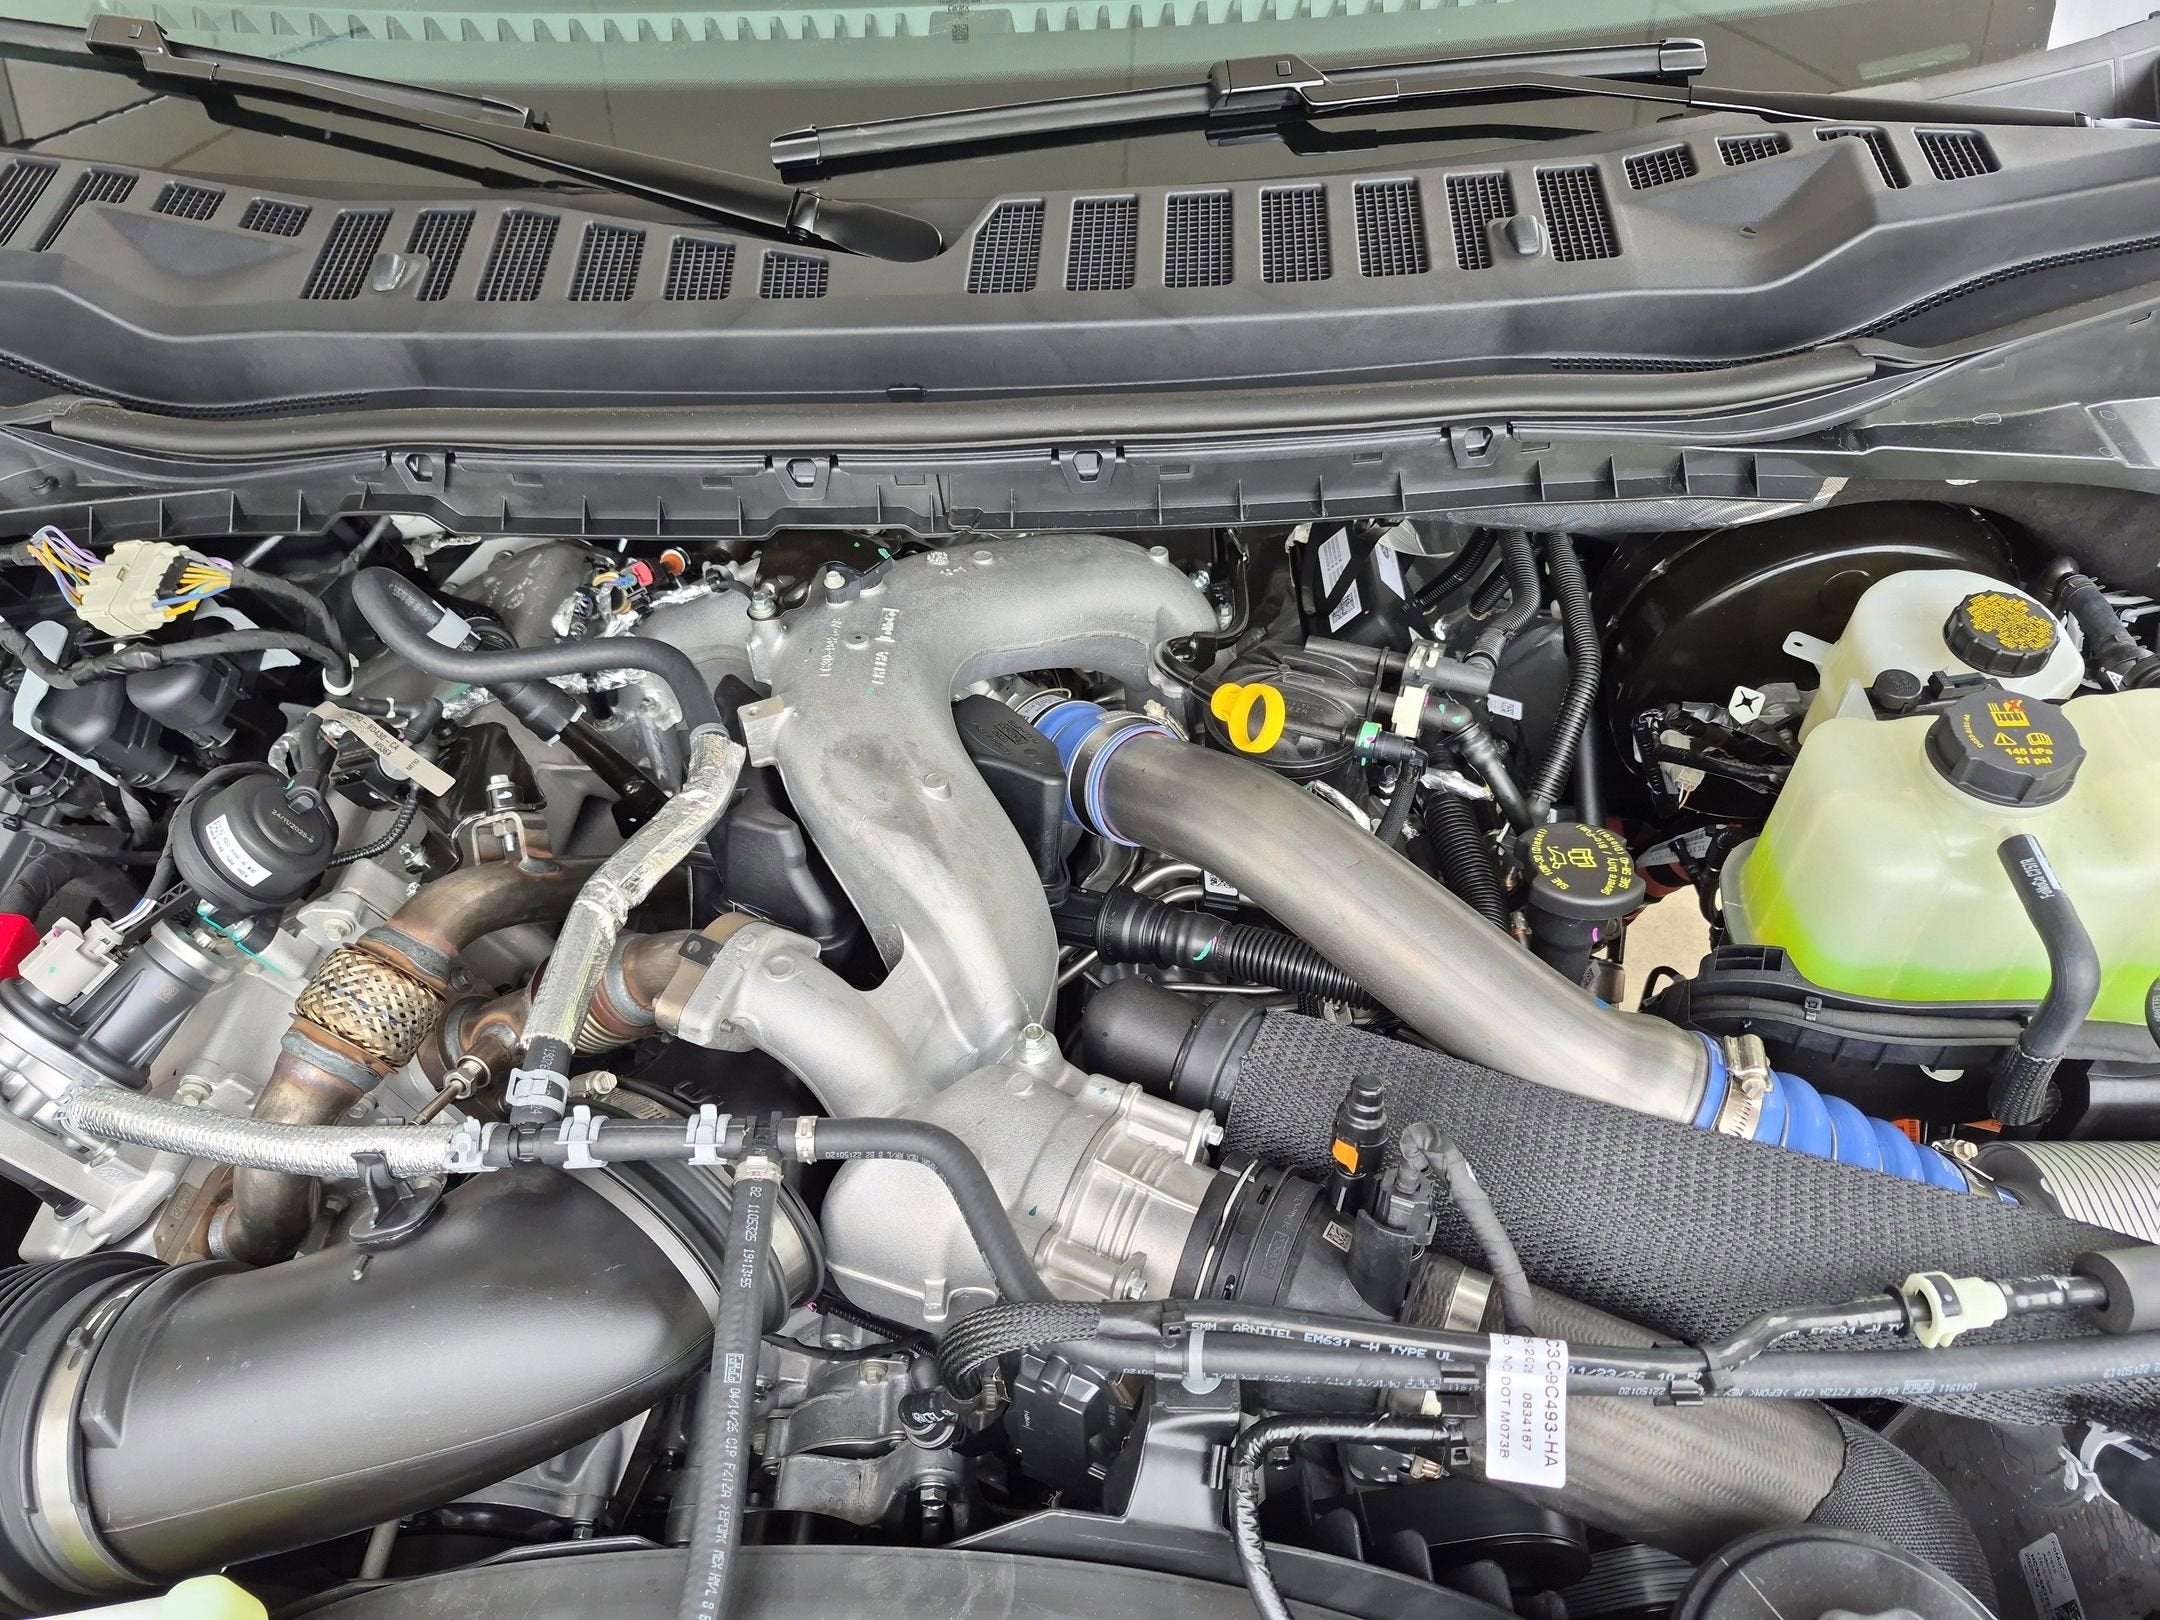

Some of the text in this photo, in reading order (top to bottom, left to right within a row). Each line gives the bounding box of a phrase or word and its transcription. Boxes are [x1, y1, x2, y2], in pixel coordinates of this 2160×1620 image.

[2005, 747, 2054, 756] 145 kPa
[2015, 756, 2053, 766] 21 psi
[2031, 876, 2056, 900] FoMoCo
[825, 1151, 862, 1159] 22:50:20
[744, 1203, 761, 1243] 1105325
[740, 1248, 756, 1289] 19:13:55
[1232, 1322, 1296, 1340] ARNITEL
[1303, 1332, 1351, 1349] EM631
[1389, 1344, 1428, 1359] TYPE
[1436, 1350, 1456, 1362] UL
[2103, 1363, 2151, 1379] 22:50:19
[1500, 1376, 1512, 1407] DOT
[1618, 1386, 1666, 1396] 22:50:20
[1793, 1388, 1815, 1397] CIP
[1522, 1392, 1533, 1451] 0834167
[1499, 1411, 1512, 1459] M073B
[725, 1437, 739, 1458] CIP
[711, 1549, 725, 1570] MEX
